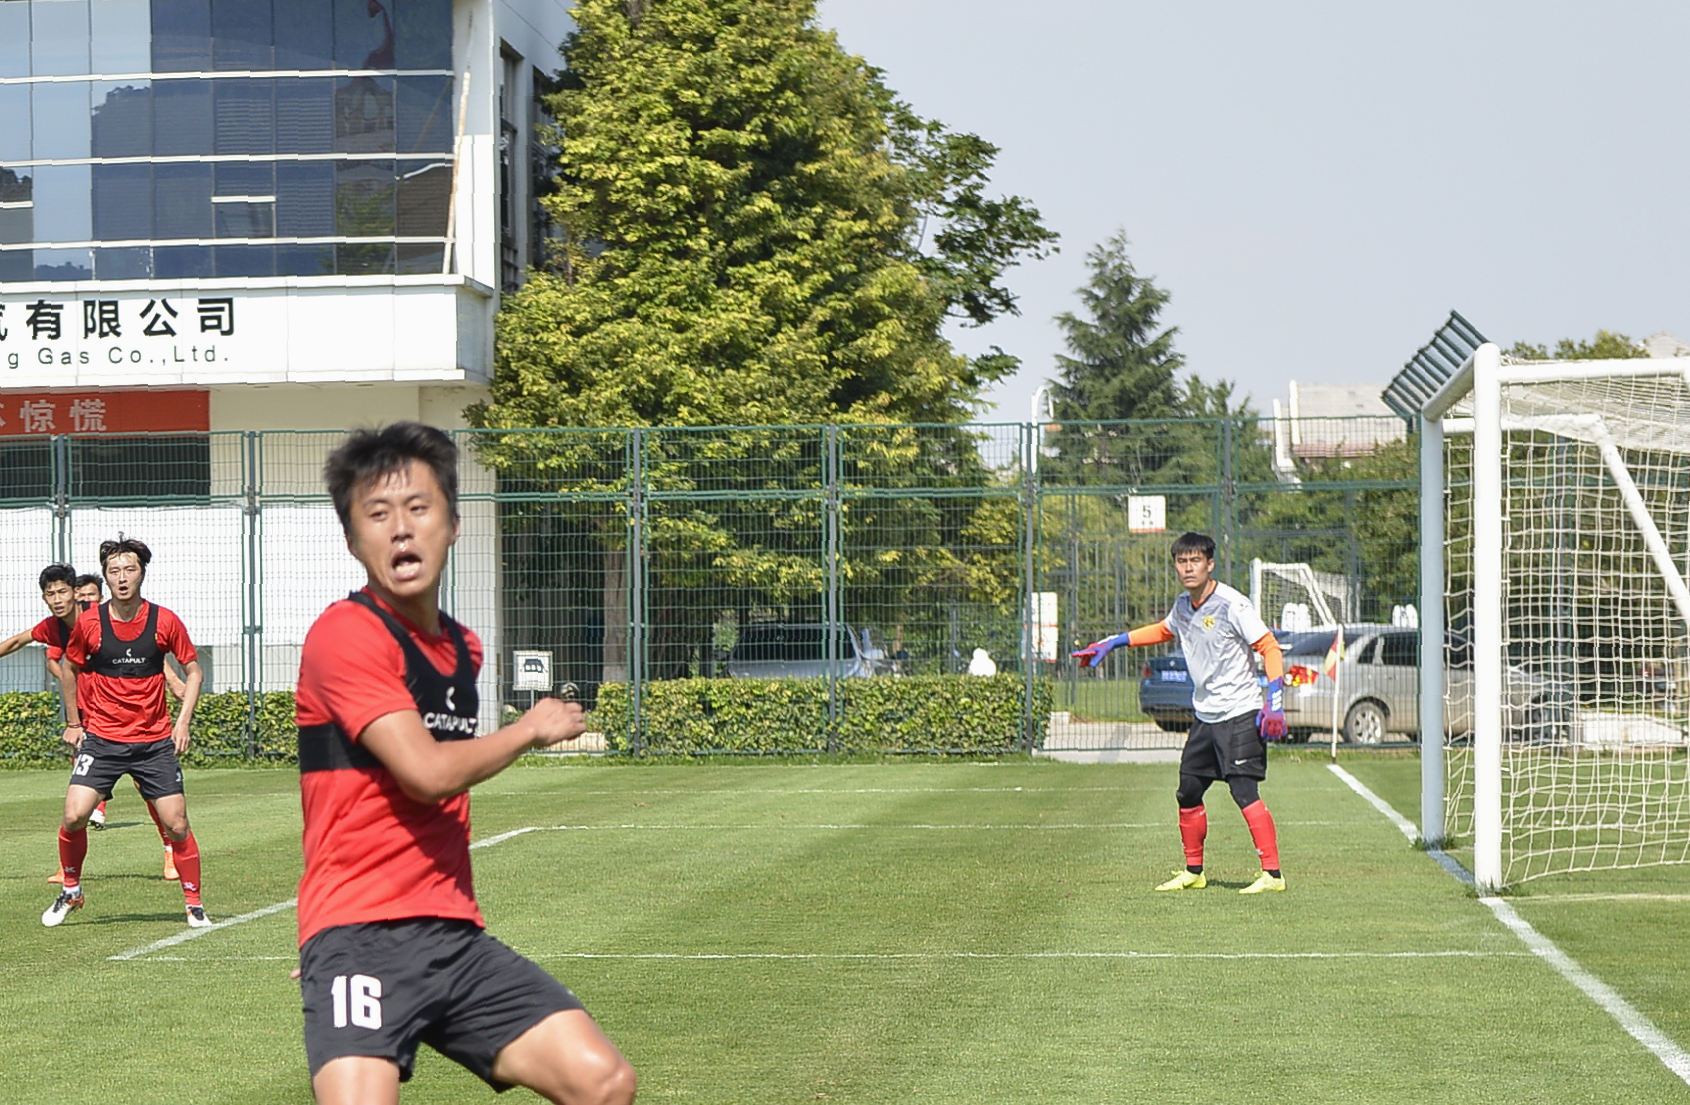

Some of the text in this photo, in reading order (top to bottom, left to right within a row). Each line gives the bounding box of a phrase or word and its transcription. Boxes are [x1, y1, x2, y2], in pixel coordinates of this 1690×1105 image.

[37, 347, 90, 365] Gas
[1142, 504, 1152, 519] 5
[112, 657, 146, 665] CATAPULT
[423, 711, 477, 734] CATAPULT
[331, 973, 382, 1030] 16
